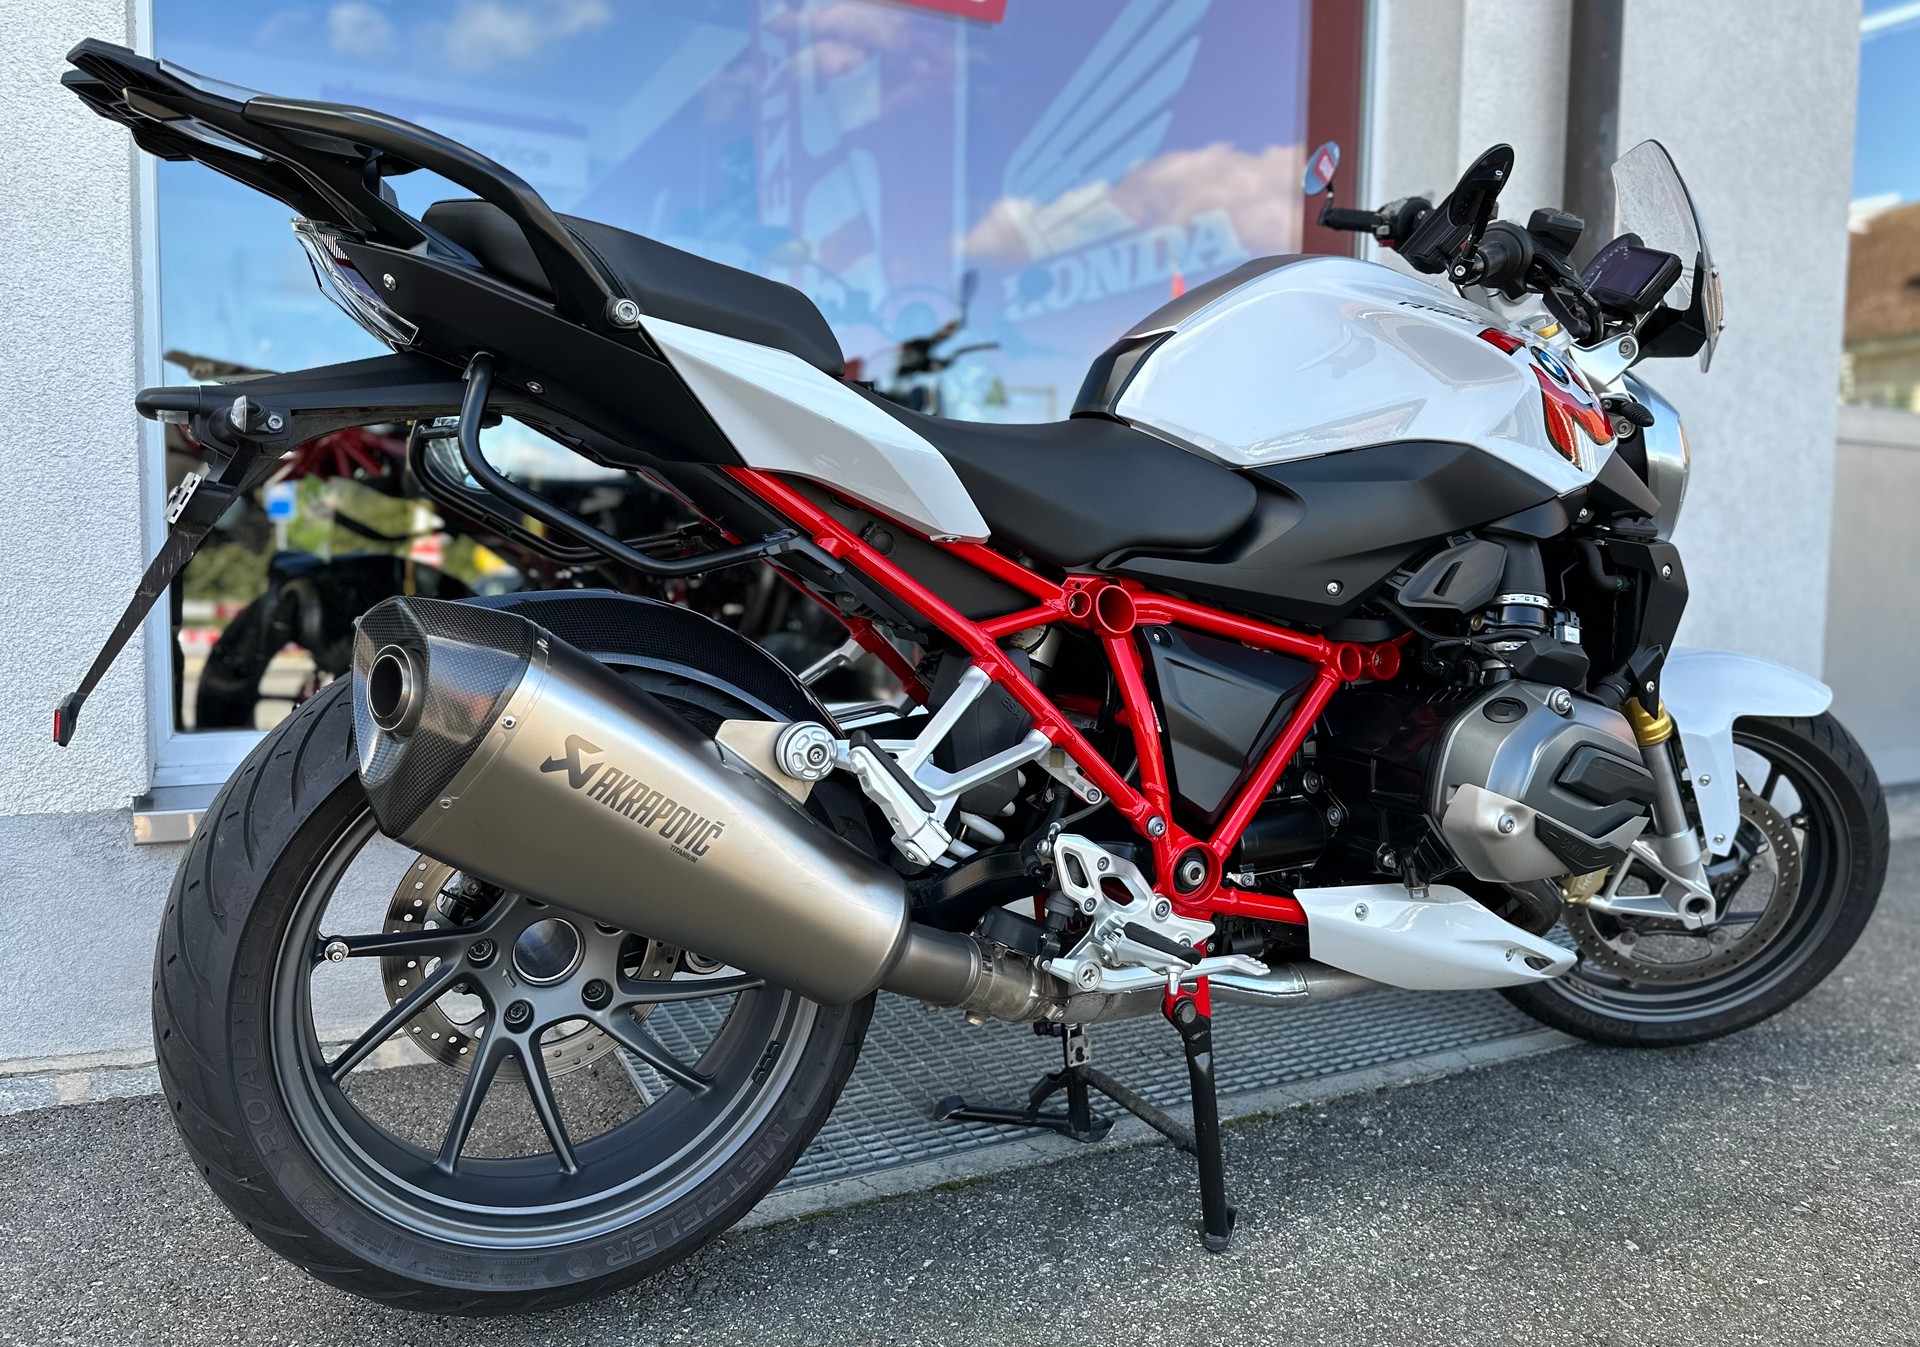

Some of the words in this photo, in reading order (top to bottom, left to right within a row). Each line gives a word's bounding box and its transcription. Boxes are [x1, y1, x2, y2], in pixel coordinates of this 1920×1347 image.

[668, 844, 698, 863] TITANIUM
[230, 954, 290, 1157] ROADTEC
[603, 1123, 790, 1267] METZELER
